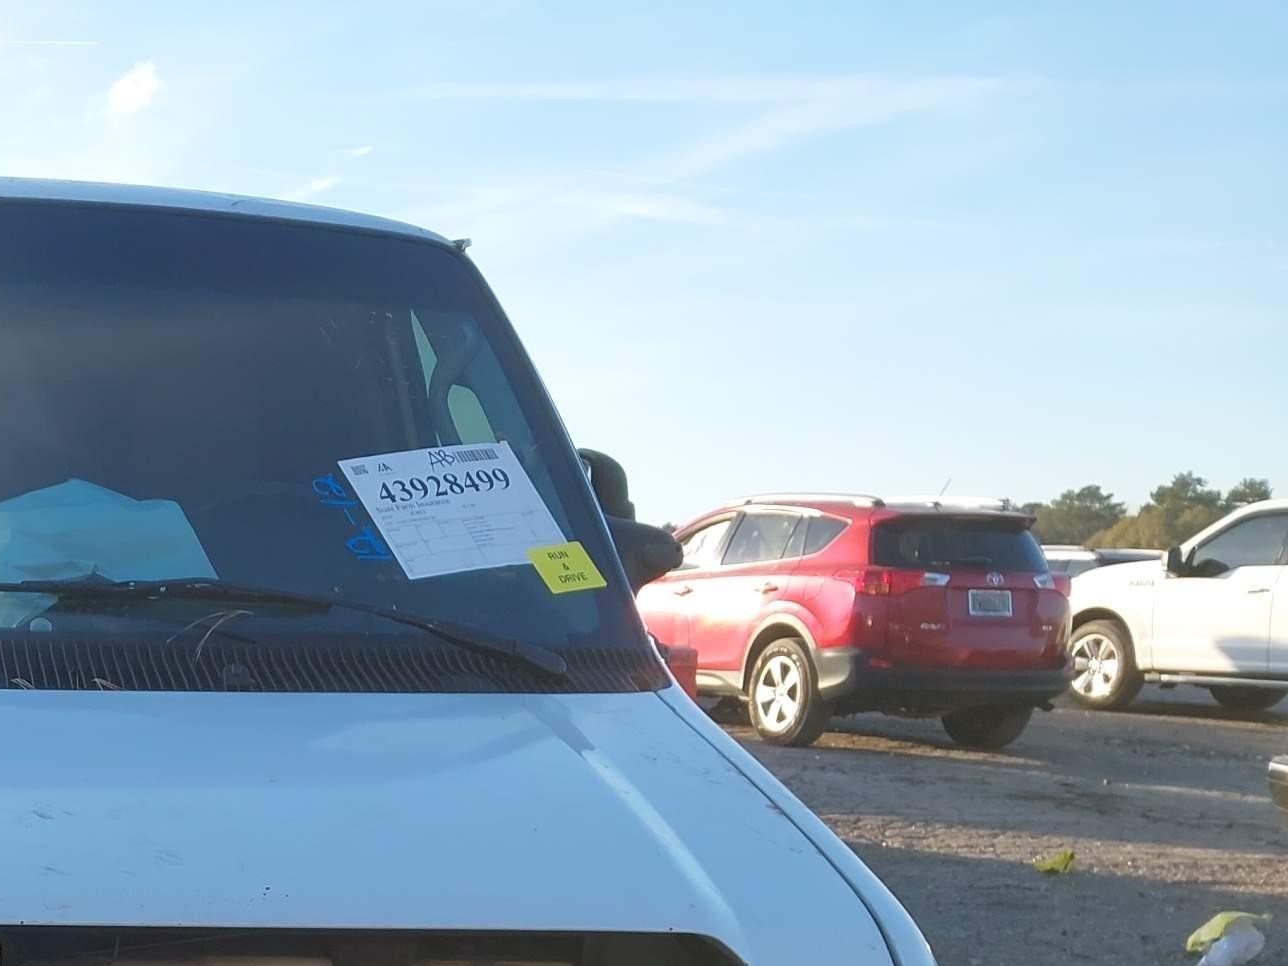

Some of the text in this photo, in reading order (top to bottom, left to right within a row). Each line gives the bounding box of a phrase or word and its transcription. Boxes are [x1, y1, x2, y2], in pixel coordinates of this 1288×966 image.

[379, 468, 511, 504] 43928499
[547, 551, 569, 561] RUN
[561, 562, 570, 571] &
[558, 572, 589, 584] DRIVE
